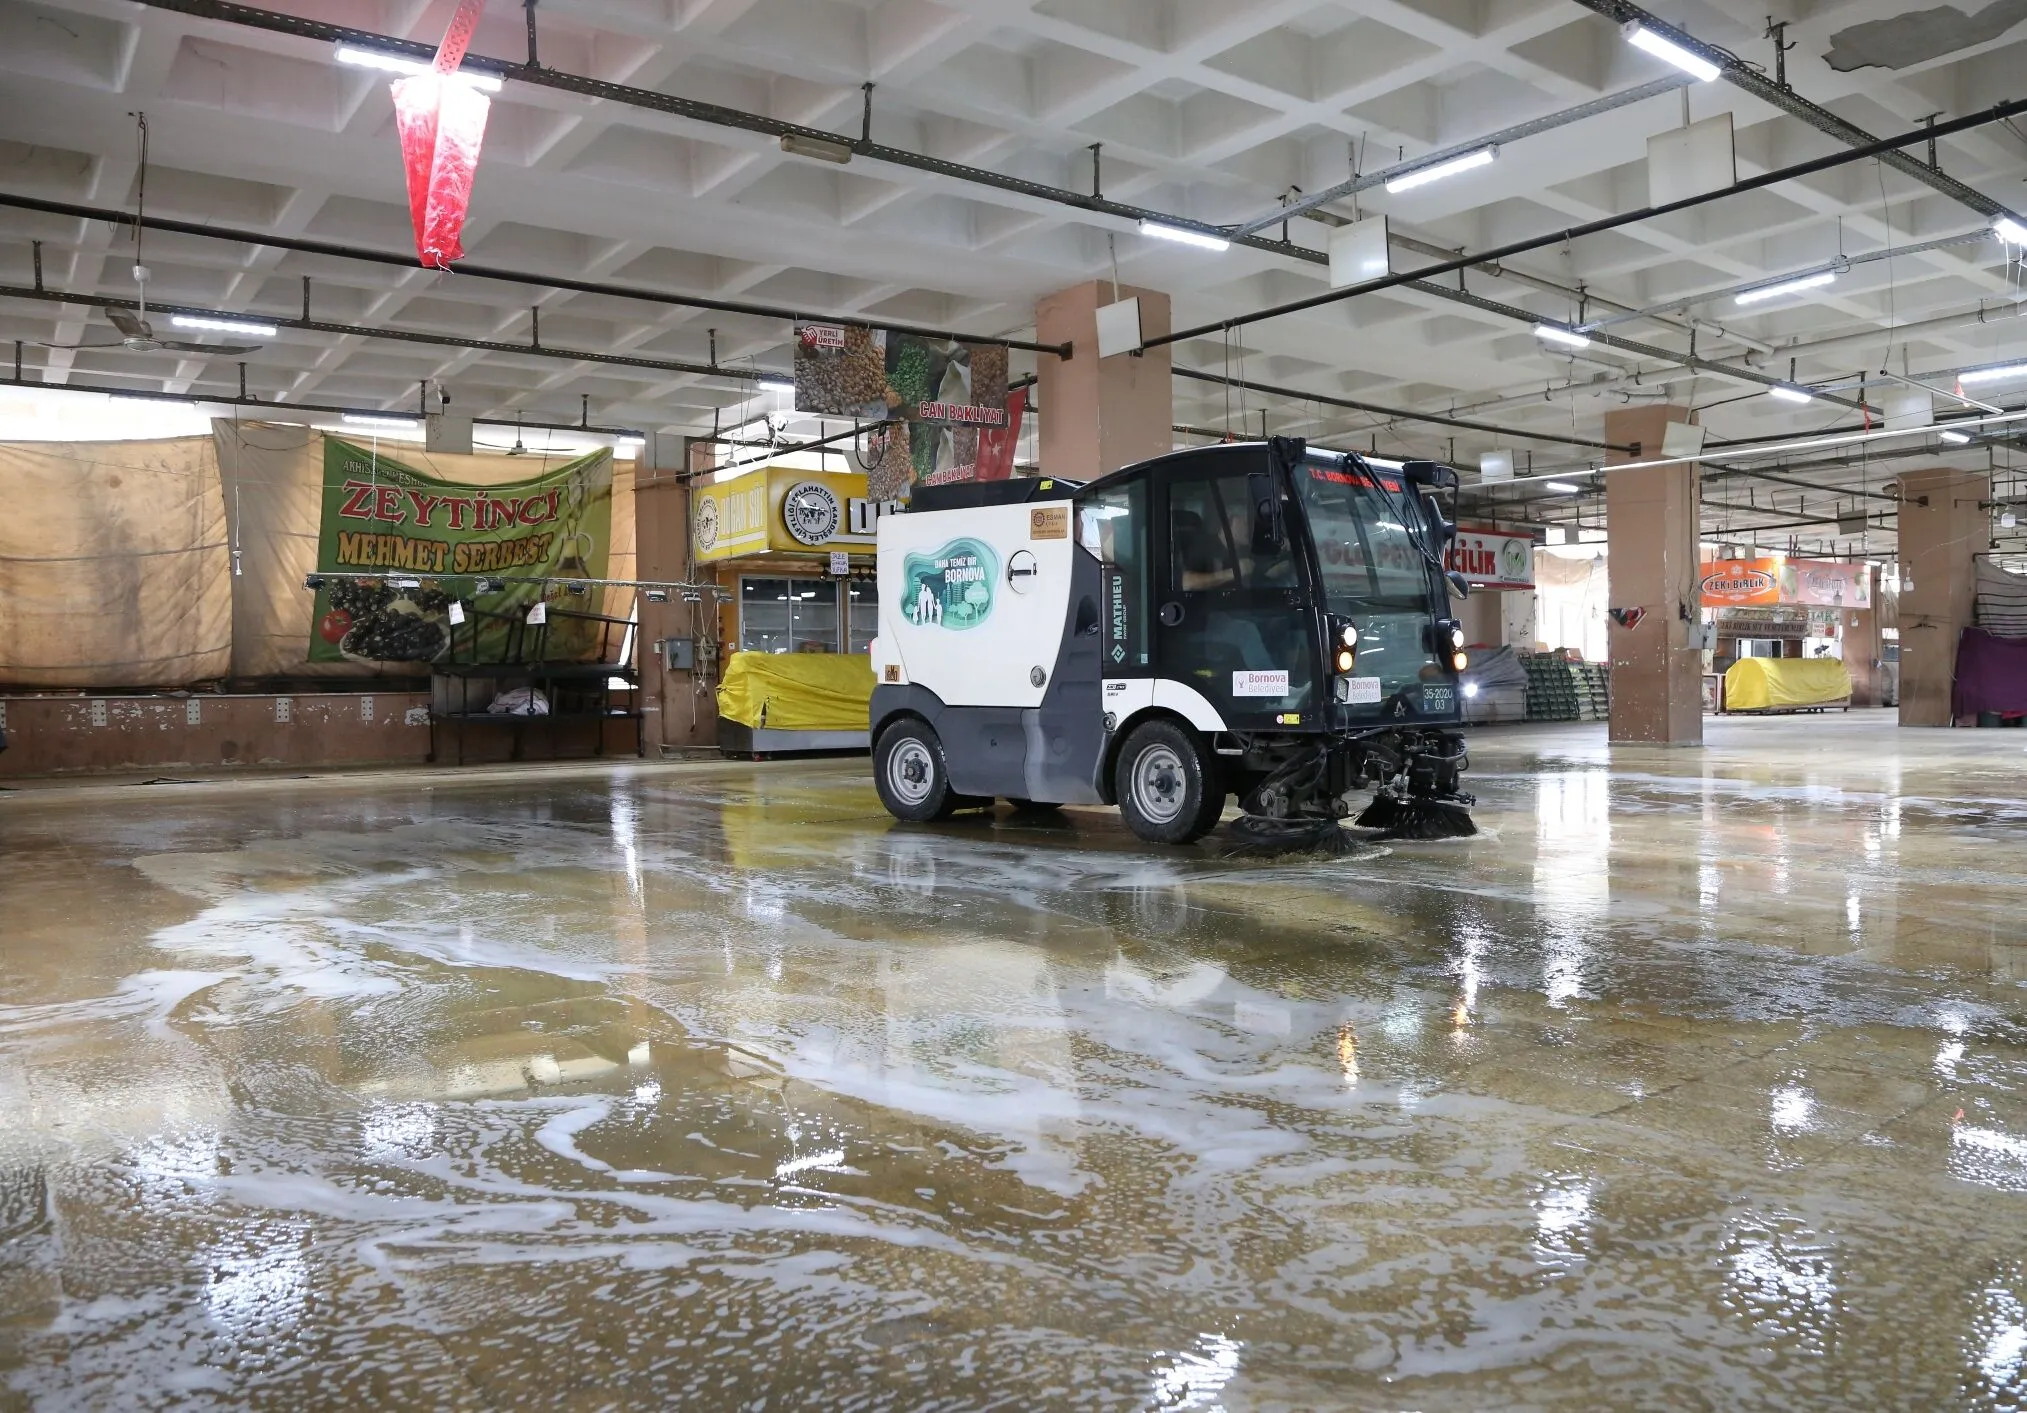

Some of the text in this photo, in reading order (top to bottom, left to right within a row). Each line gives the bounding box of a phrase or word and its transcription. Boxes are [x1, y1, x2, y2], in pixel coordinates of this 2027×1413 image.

[819, 336, 844, 346] ÜRETİM
[920, 401, 1004, 424] CAN BAKLİYAT
[337, 530, 554, 575] MEHMET SERBEST
[950, 556, 966, 567] TEMİZ
[945, 567, 985, 583] BORNOVA
[1112, 576, 1123, 640] MATHIEU
[1249, 673, 1286, 683] Bornova
[1249, 684, 1286, 694] Belediyesi
[1351, 680, 1379, 690] Bornova
[1424, 688, 1453, 699] 35-2020
[1434, 700, 1445, 710] 03
